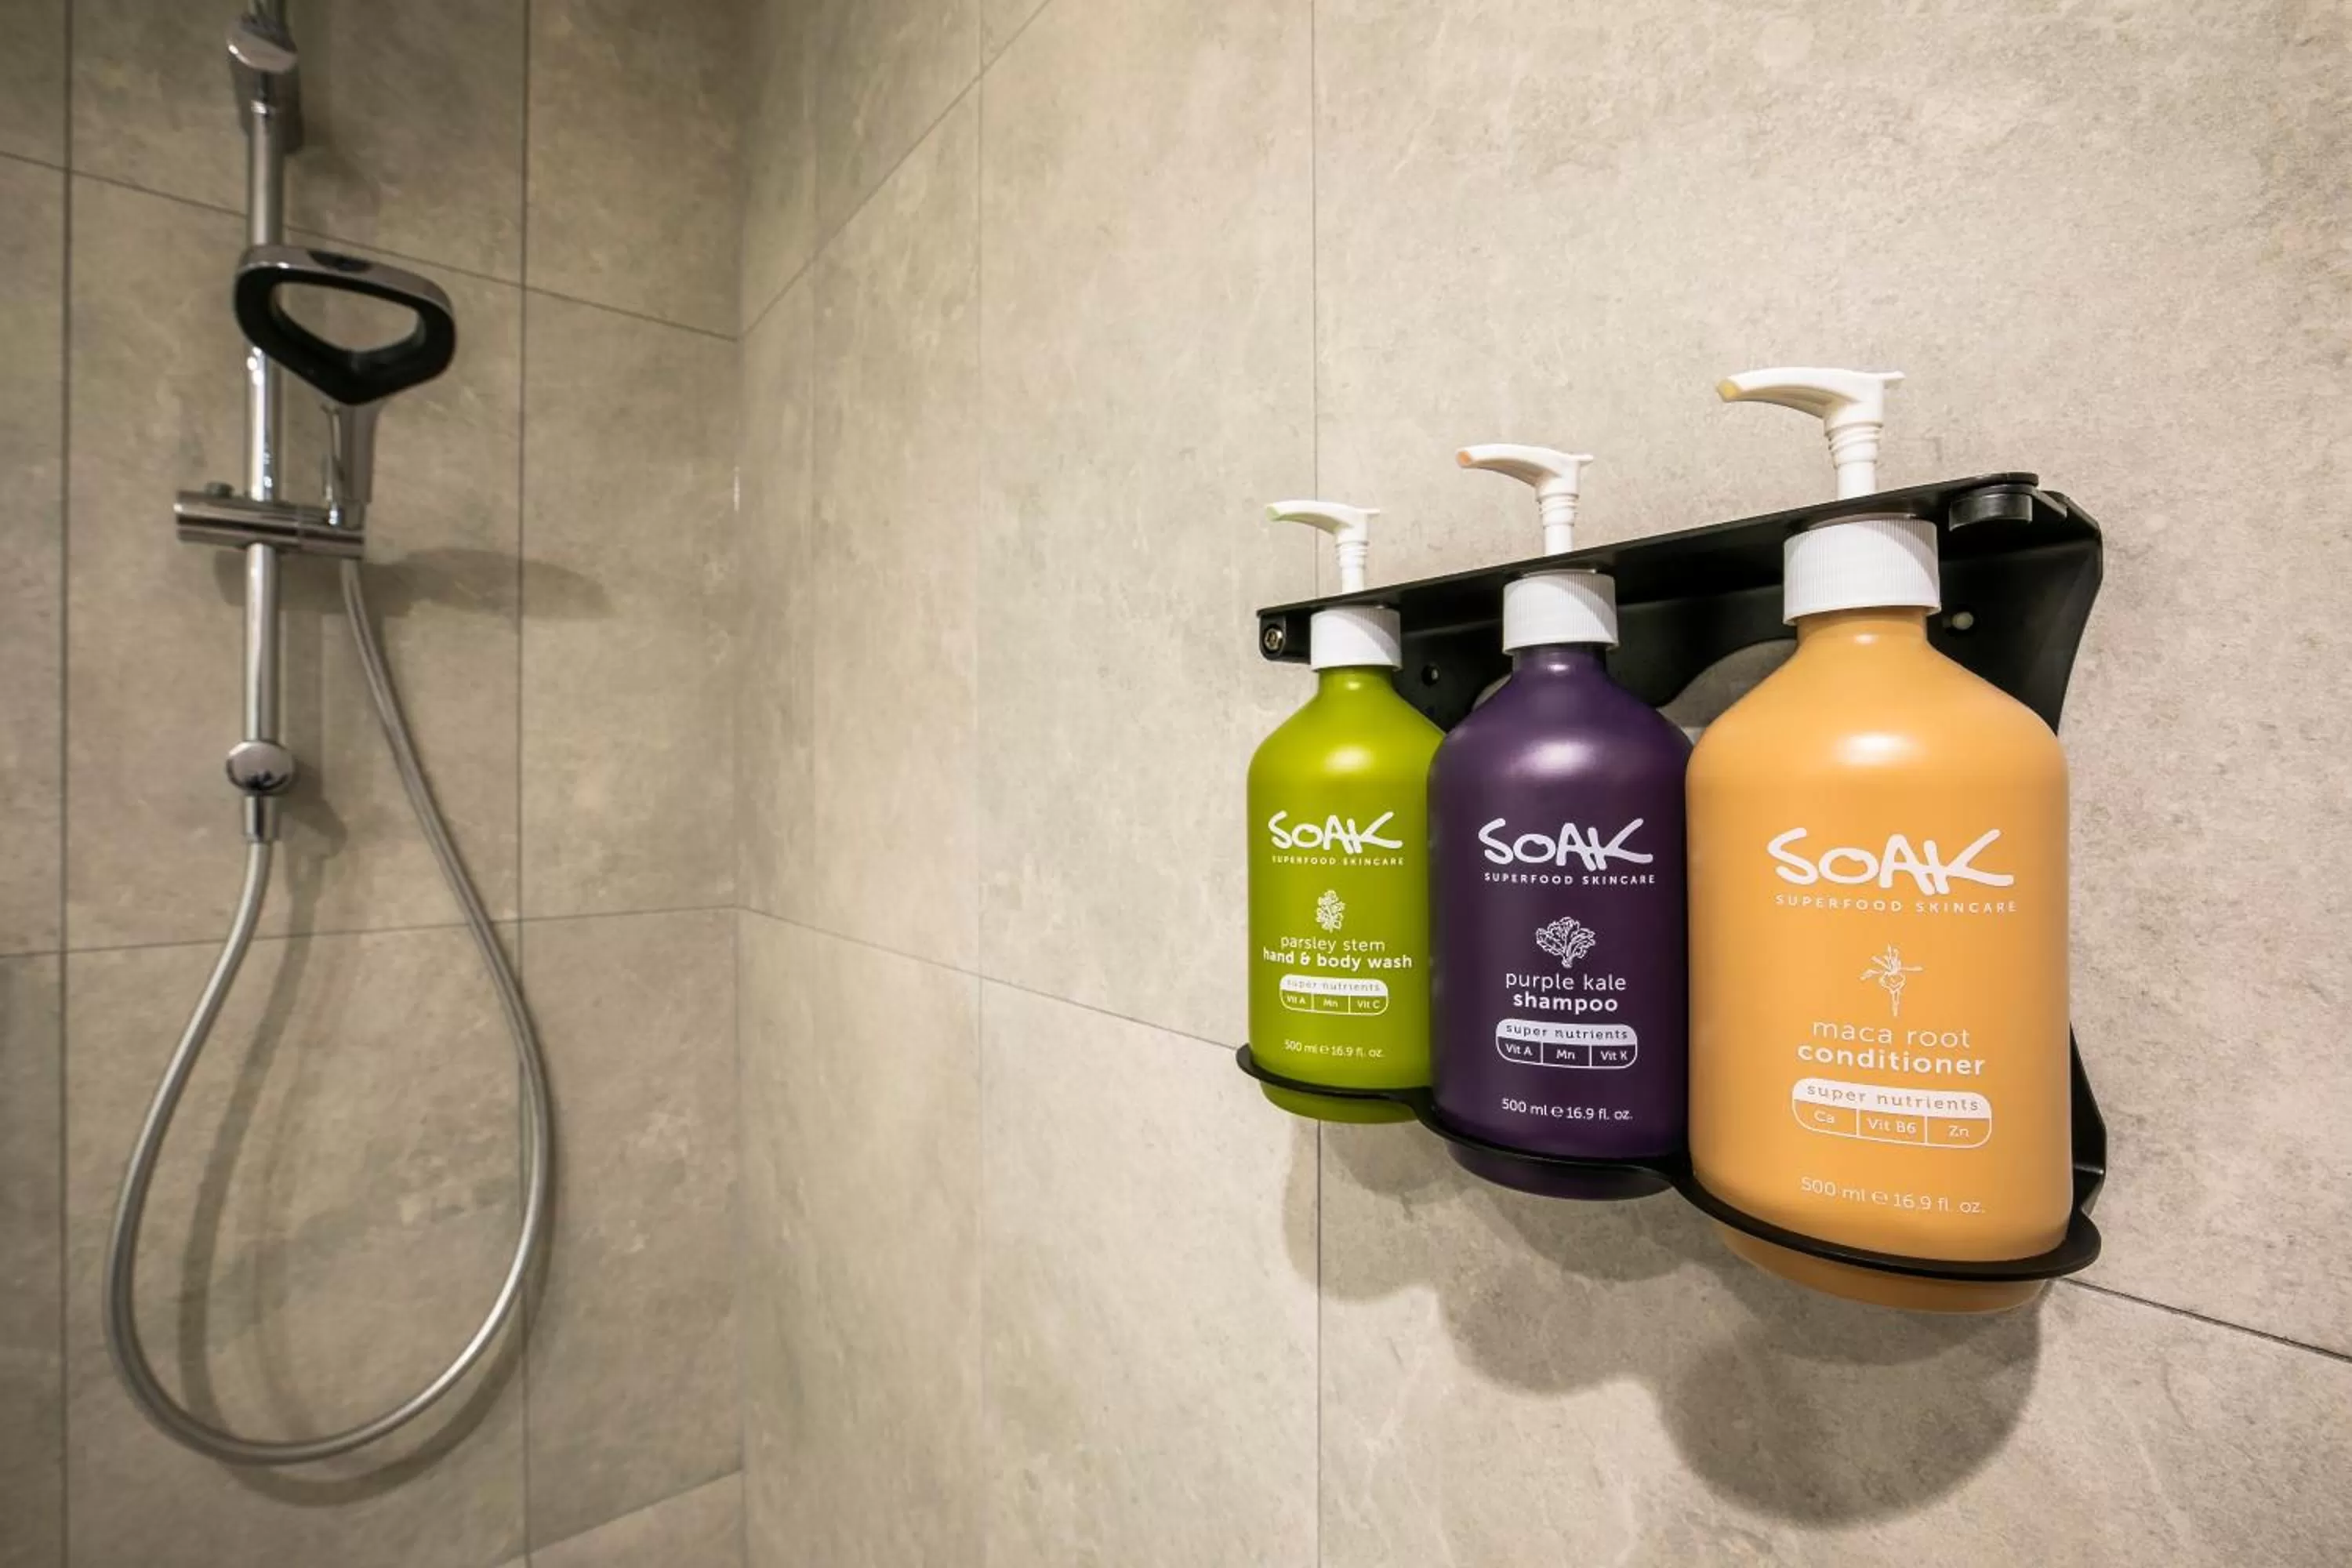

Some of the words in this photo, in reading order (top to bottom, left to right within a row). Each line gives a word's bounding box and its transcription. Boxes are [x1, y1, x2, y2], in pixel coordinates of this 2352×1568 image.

[1268, 811, 1403, 855] SOAK
[1479, 818, 1653, 871] SOAK
[1272, 855, 1336, 866] SUPERFOOD
[1343, 857, 1404, 866] SKINCARE
[1767, 827, 2015, 895] SOAK
[1484, 872, 1573, 885] SUPERFOOD
[1581, 875, 1656, 885] SKINCARE
[1775, 894, 1902, 912] SUPERFOOD
[1915, 900, 2017, 913] SKINCARE
[1280, 935, 1337, 953] parsley
[1343, 940, 1385, 953] stem
[1263, 947, 1294, 964] hand
[1301, 953, 1311, 965] &
[1316, 953, 1361, 972] body
[1367, 955, 1412, 969] wash
[1286, 978, 1318, 990] super
[1322, 981, 1380, 992] nutrients
[1505, 971, 1574, 992] purple
[1583, 973, 1627, 991] kale
[1287, 995, 1298, 1004] Vit
[1298, 996, 1306, 1005] A
[1323, 999, 1338, 1008] Mn
[1357, 999, 1370, 1009] Vit
[1371, 1000, 1380, 1009] C
[1513, 991, 1618, 1014] shampoo
[1505, 1023, 1548, 1037] super
[1555, 1027, 1628, 1040] nutrients
[1812, 1021, 1893, 1044] maca
[1907, 1026, 1970, 1048] root
[1284, 1040, 1301, 1051] 500
[1304, 1042, 1318, 1054] ml
[1332, 1045, 1352, 1057] 16.9
[1505, 1043, 1523, 1055] Vit
[1523, 1046, 1533, 1056] A
[1556, 1049, 1575, 1060] Mn
[1600, 1050, 1616, 1061] Vit
[1617, 1051, 1628, 1061] K
[1797, 1044, 1986, 1076] conditioner
[1806, 1083, 1867, 1103] super
[1876, 1091, 1979, 1112] nutrients
[1501, 1098, 1526, 1112] 500
[1530, 1103, 1548, 1116] ml
[1566, 1107, 1595, 1120] 16.9
[1599, 1109, 1610, 1120] fl.
[1614, 1110, 1633, 1120] oz.
[1813, 1110, 1835, 1124] Ca
[1866, 1116, 1893, 1133] Vit
[1896, 1120, 1917, 1134] B6
[1947, 1125, 1969, 1138] Zn
[1801, 1176, 1835, 1196] 500
[1842, 1185, 1864, 1203] ml
[1893, 1193, 1931, 1211] 16.9
[1960, 1200, 1986, 1214] oz.
